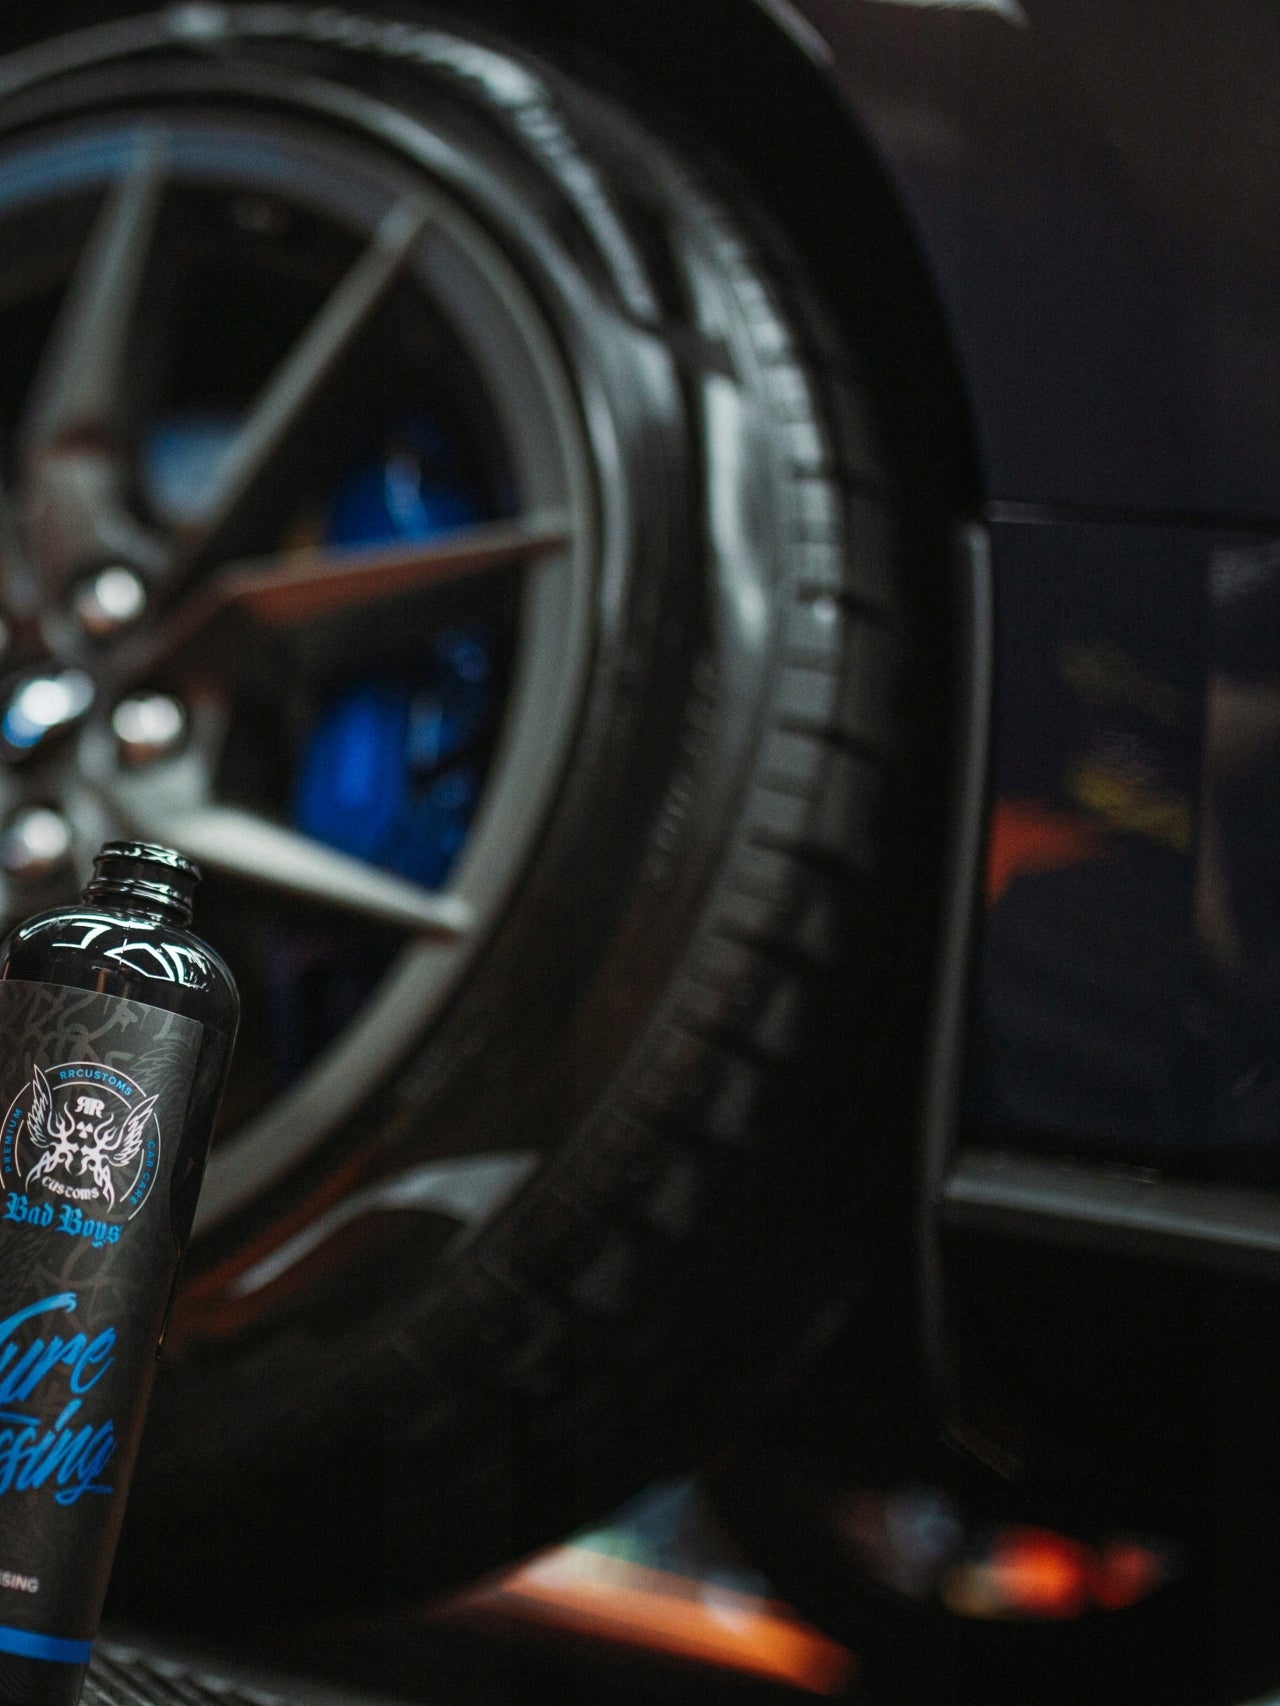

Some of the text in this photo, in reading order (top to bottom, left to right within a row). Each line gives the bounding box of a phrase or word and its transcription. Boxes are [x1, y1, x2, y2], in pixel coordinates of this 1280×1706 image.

[60, 1069, 132, 1096] RRCUSTOMS
[3, 1109, 22, 1173] PREMIUM
[130, 1140, 156, 1205] CAR CARE
[3, 1192, 123, 1247] Bad Boys
